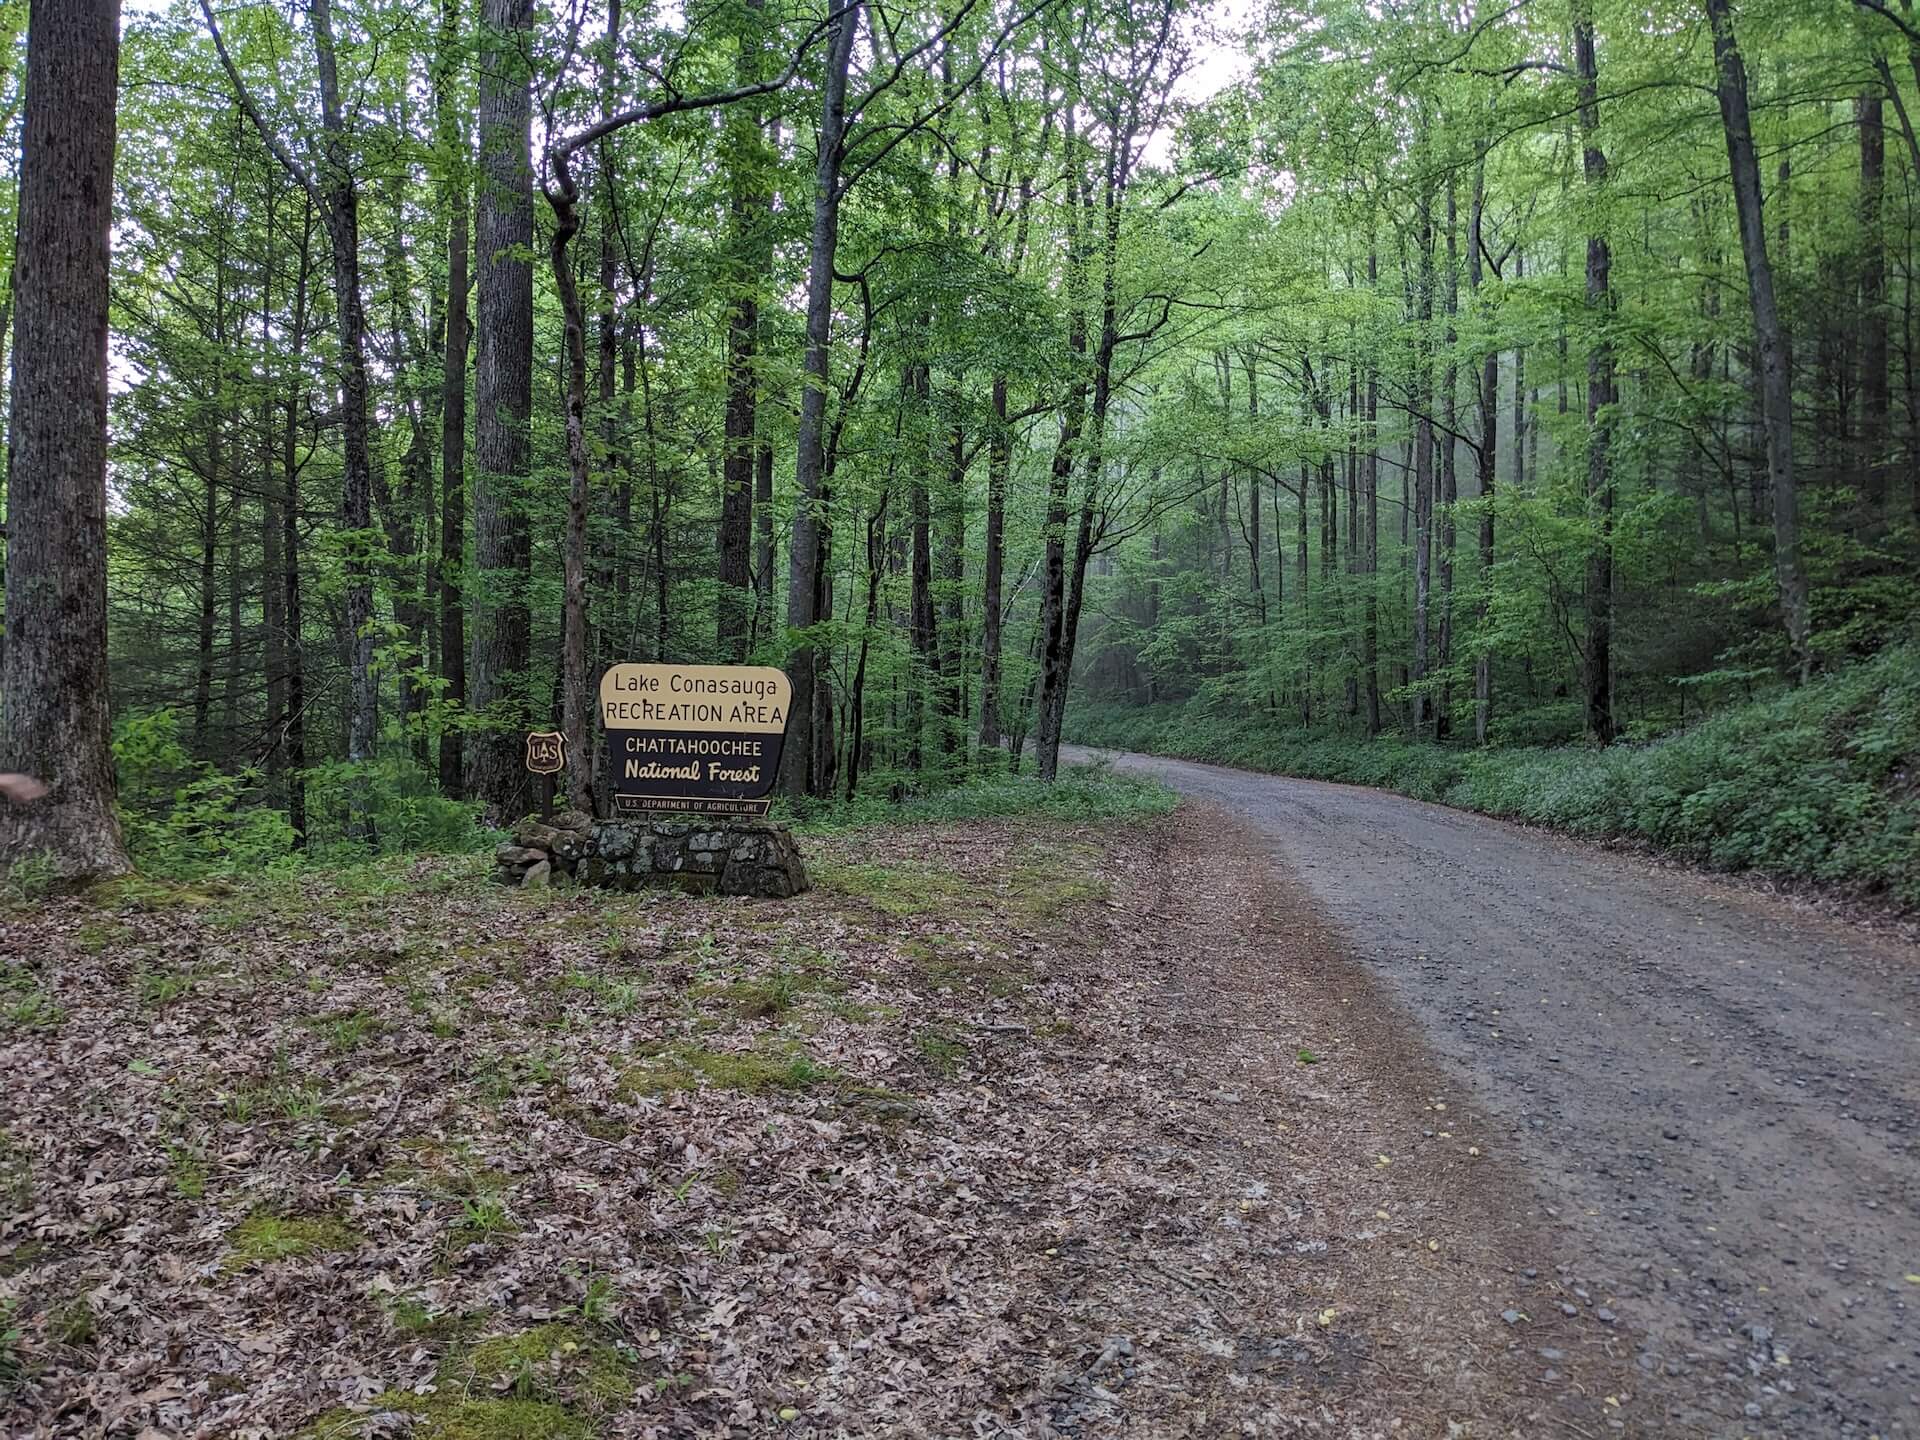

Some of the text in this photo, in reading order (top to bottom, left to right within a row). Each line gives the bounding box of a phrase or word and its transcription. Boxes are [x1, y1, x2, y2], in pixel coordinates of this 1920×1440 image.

[615, 673, 778, 701] Lake Conasauga
[606, 702, 784, 724] RECREATION AREA
[625, 737, 763, 757] CHATTAHOOCHEE
[624, 758, 761, 783] National Forest
[642, 800, 690, 809] DEPARTMENT
[694, 802, 703, 810] OF
